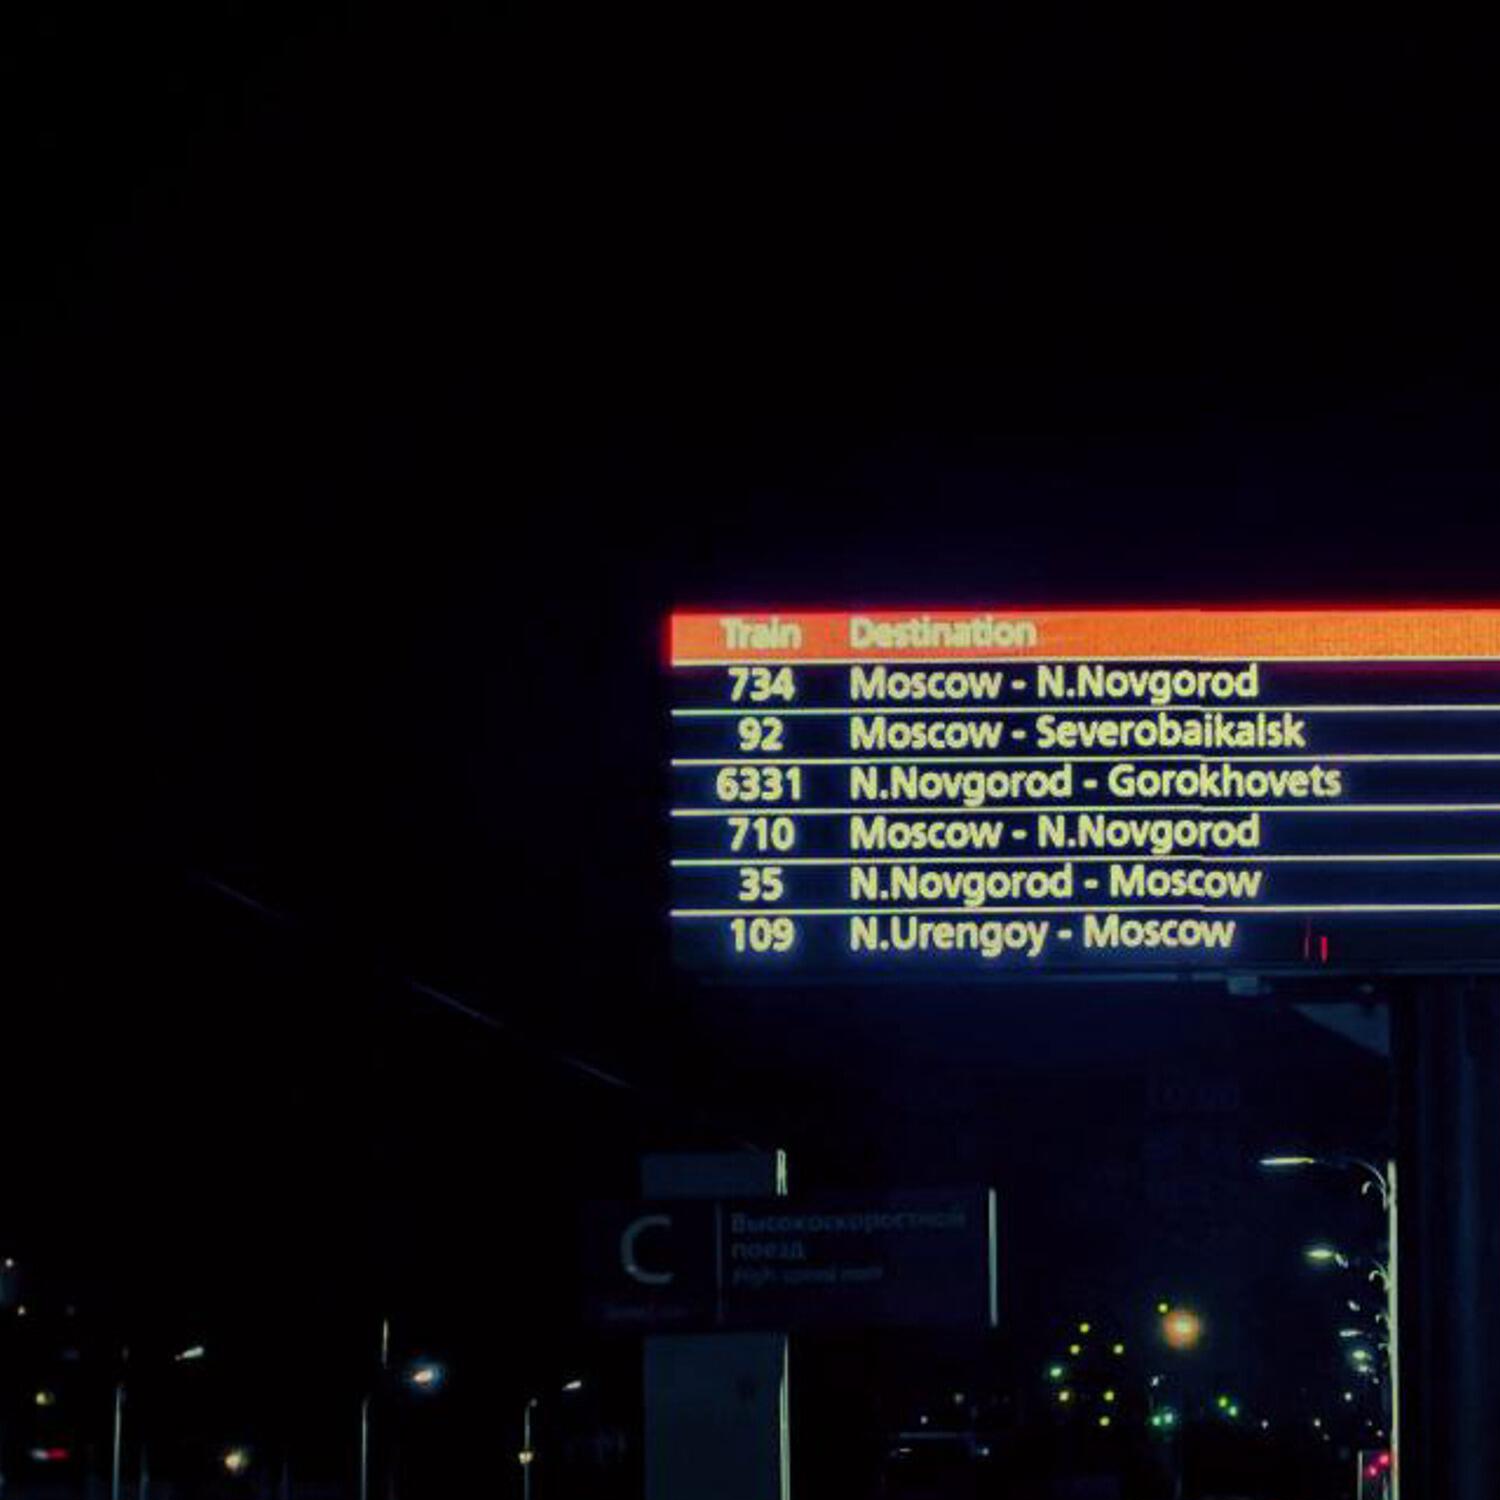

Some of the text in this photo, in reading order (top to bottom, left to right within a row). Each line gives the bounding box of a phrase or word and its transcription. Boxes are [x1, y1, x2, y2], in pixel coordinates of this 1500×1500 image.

[721, 617, 802, 650] Train
[851, 615, 1037, 649] Destination
[728, 663, 796, 702] 734
[850, 665, 1003, 700] Moscow
[1037, 663, 1259, 704] N.Novgorod
[738, 716, 784, 752] 92
[850, 715, 1004, 750] Moscow
[1035, 710, 1306, 749] Severobaikalsk
[716, 766, 801, 802] 6331
[850, 762, 1073, 808] N.Novgorod
[1107, 760, 1342, 798] Gorokhovets
[727, 816, 796, 852] 710
[850, 812, 1004, 850] Moscow
[1037, 810, 1260, 855] N.Novgorod
[738, 866, 784, 902] 35
[850, 862, 1073, 907] N.Novgorod
[1109, 863, 1263, 899] Moscow
[730, 917, 796, 953] 109
[850, 915, 1049, 958] N.Urengoy
[1083, 913, 1236, 949] Moscow
